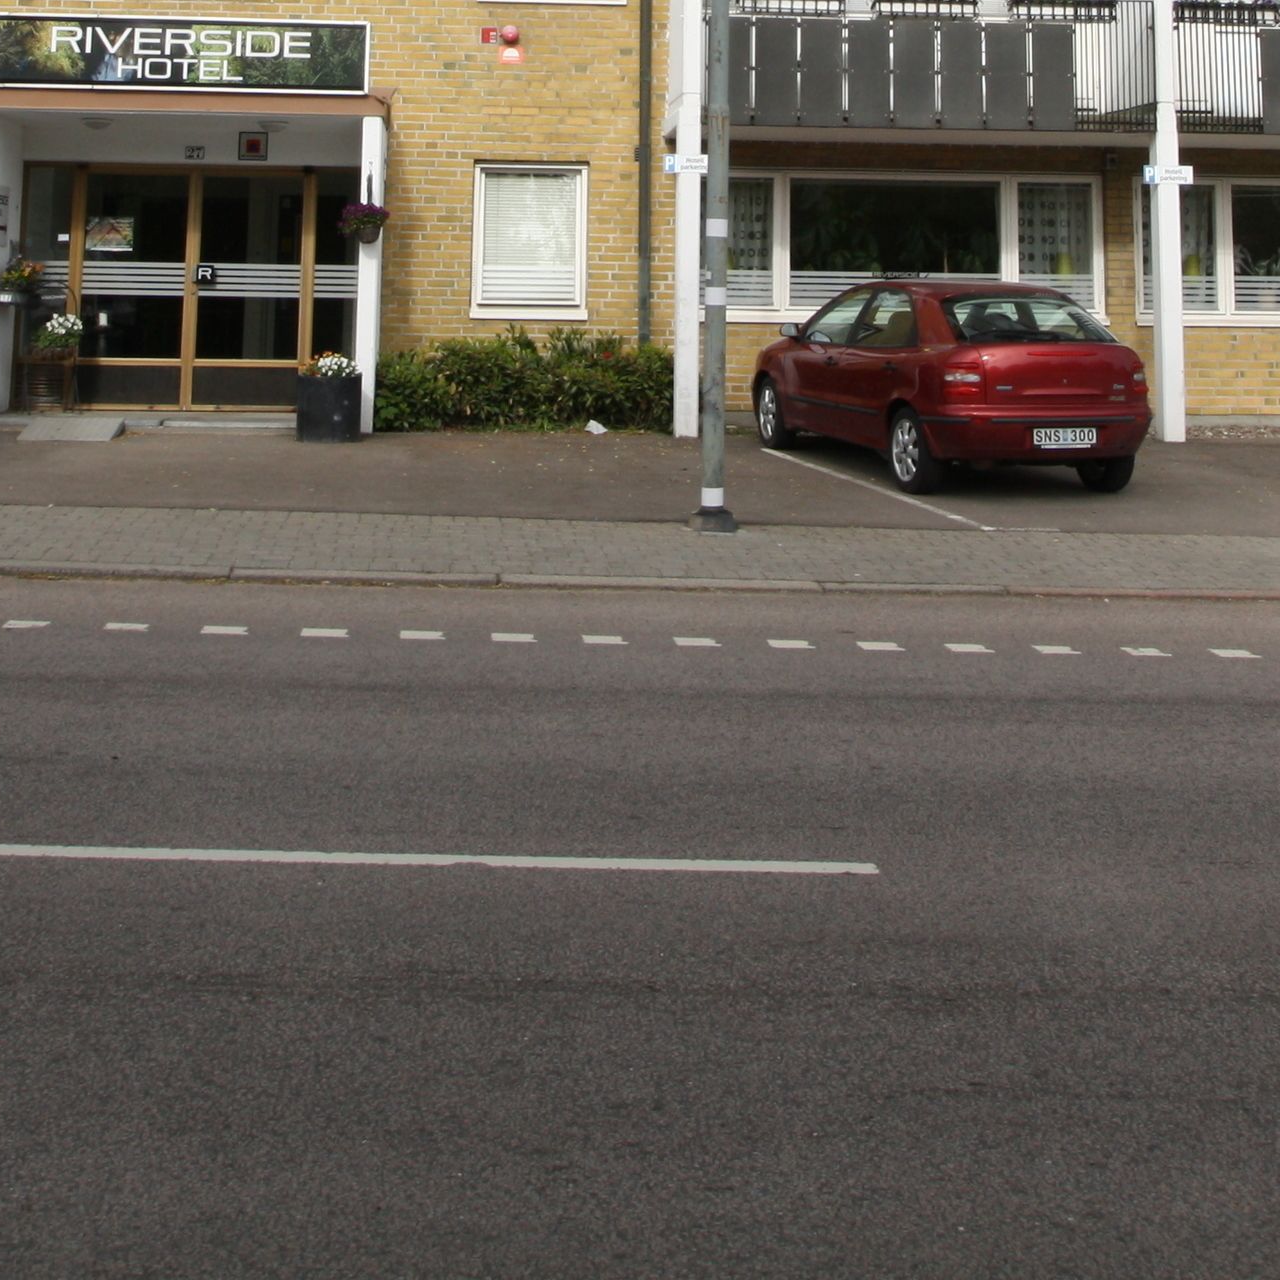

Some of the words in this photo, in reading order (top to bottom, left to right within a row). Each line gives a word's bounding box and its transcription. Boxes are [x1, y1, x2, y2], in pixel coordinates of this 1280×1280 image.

[50, 26, 312, 59] RIVERSIDE
[117, 56, 244, 82] HOTEL
[185, 146, 205, 160] 27
[665, 155, 675, 171] P
[1145, 167, 1154, 182] P
[198, 267, 212, 280] R
[1035, 430, 1061, 442] SNS
[1070, 429, 1095, 441] 300
